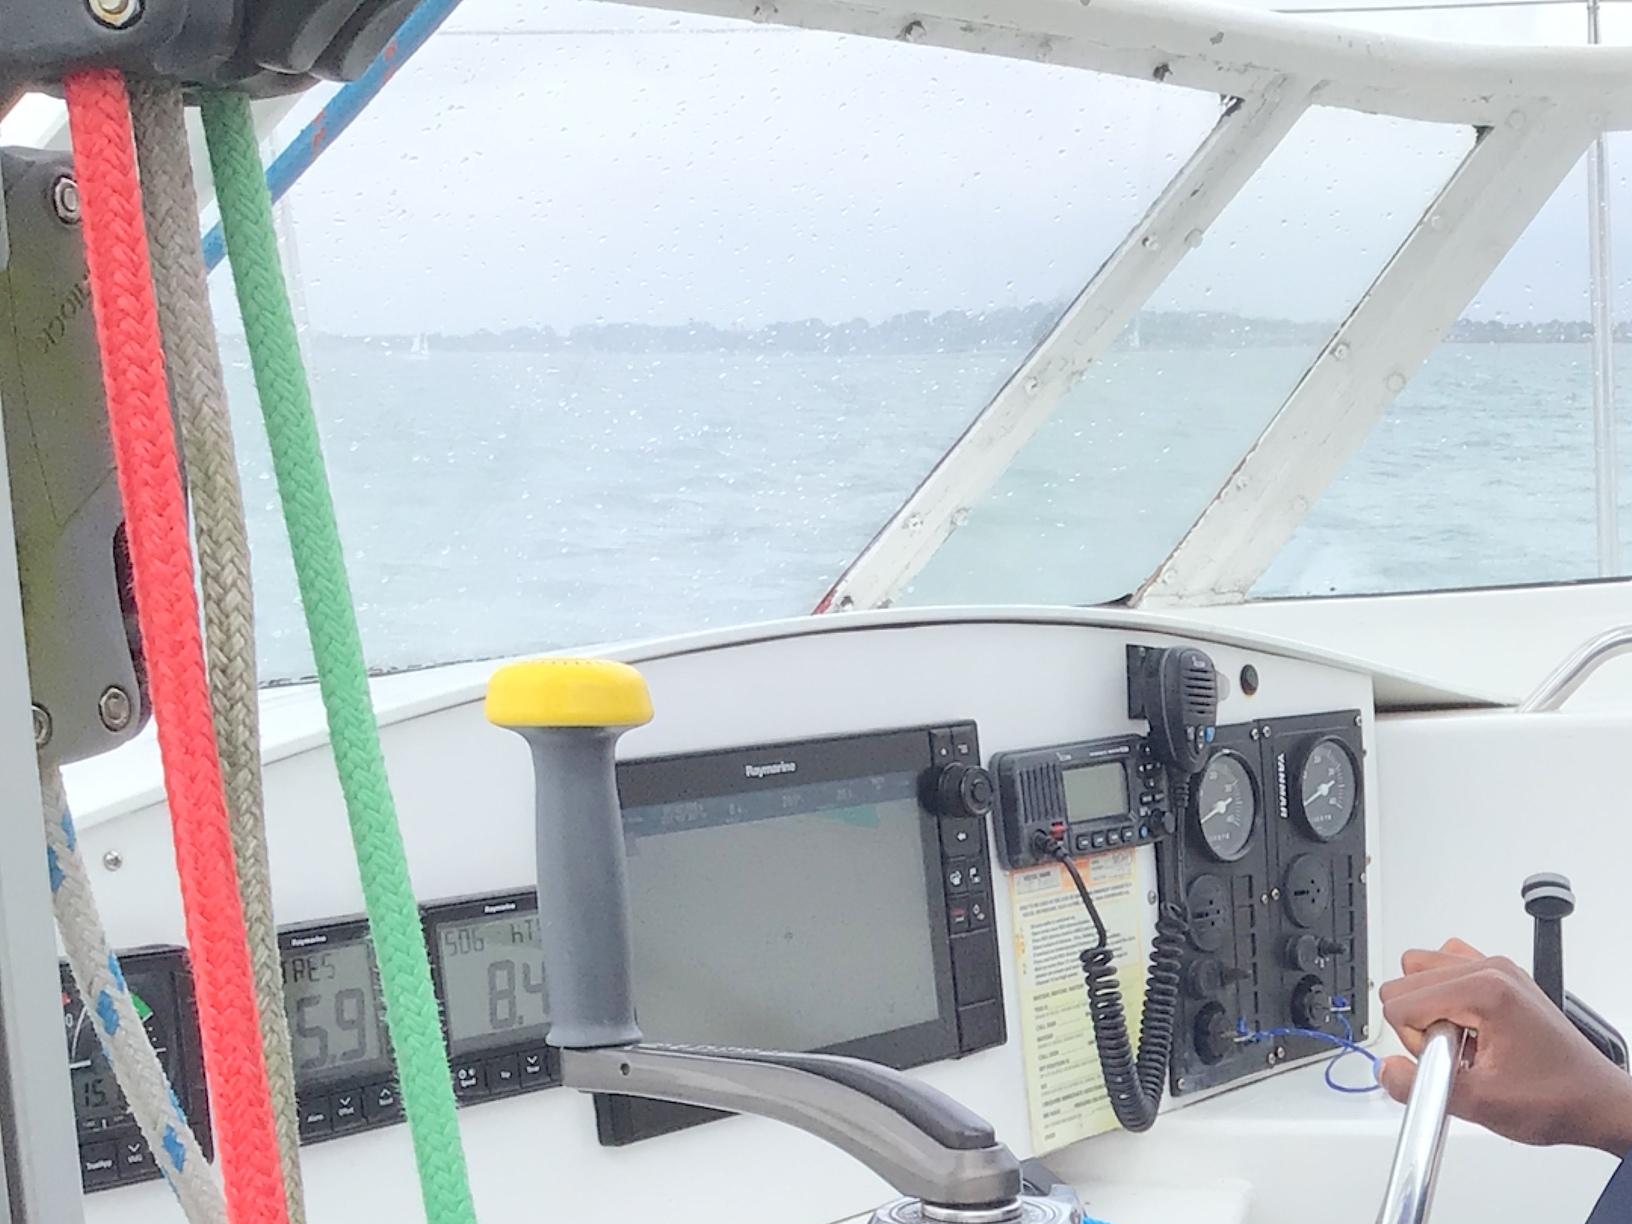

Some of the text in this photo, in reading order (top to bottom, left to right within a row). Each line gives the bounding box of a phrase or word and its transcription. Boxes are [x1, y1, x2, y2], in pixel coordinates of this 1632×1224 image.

[745, 761, 796, 777] Raymarine
[1277, 753, 1288, 819] YANMAR
[487, 959, 550, 1030] 8.4
